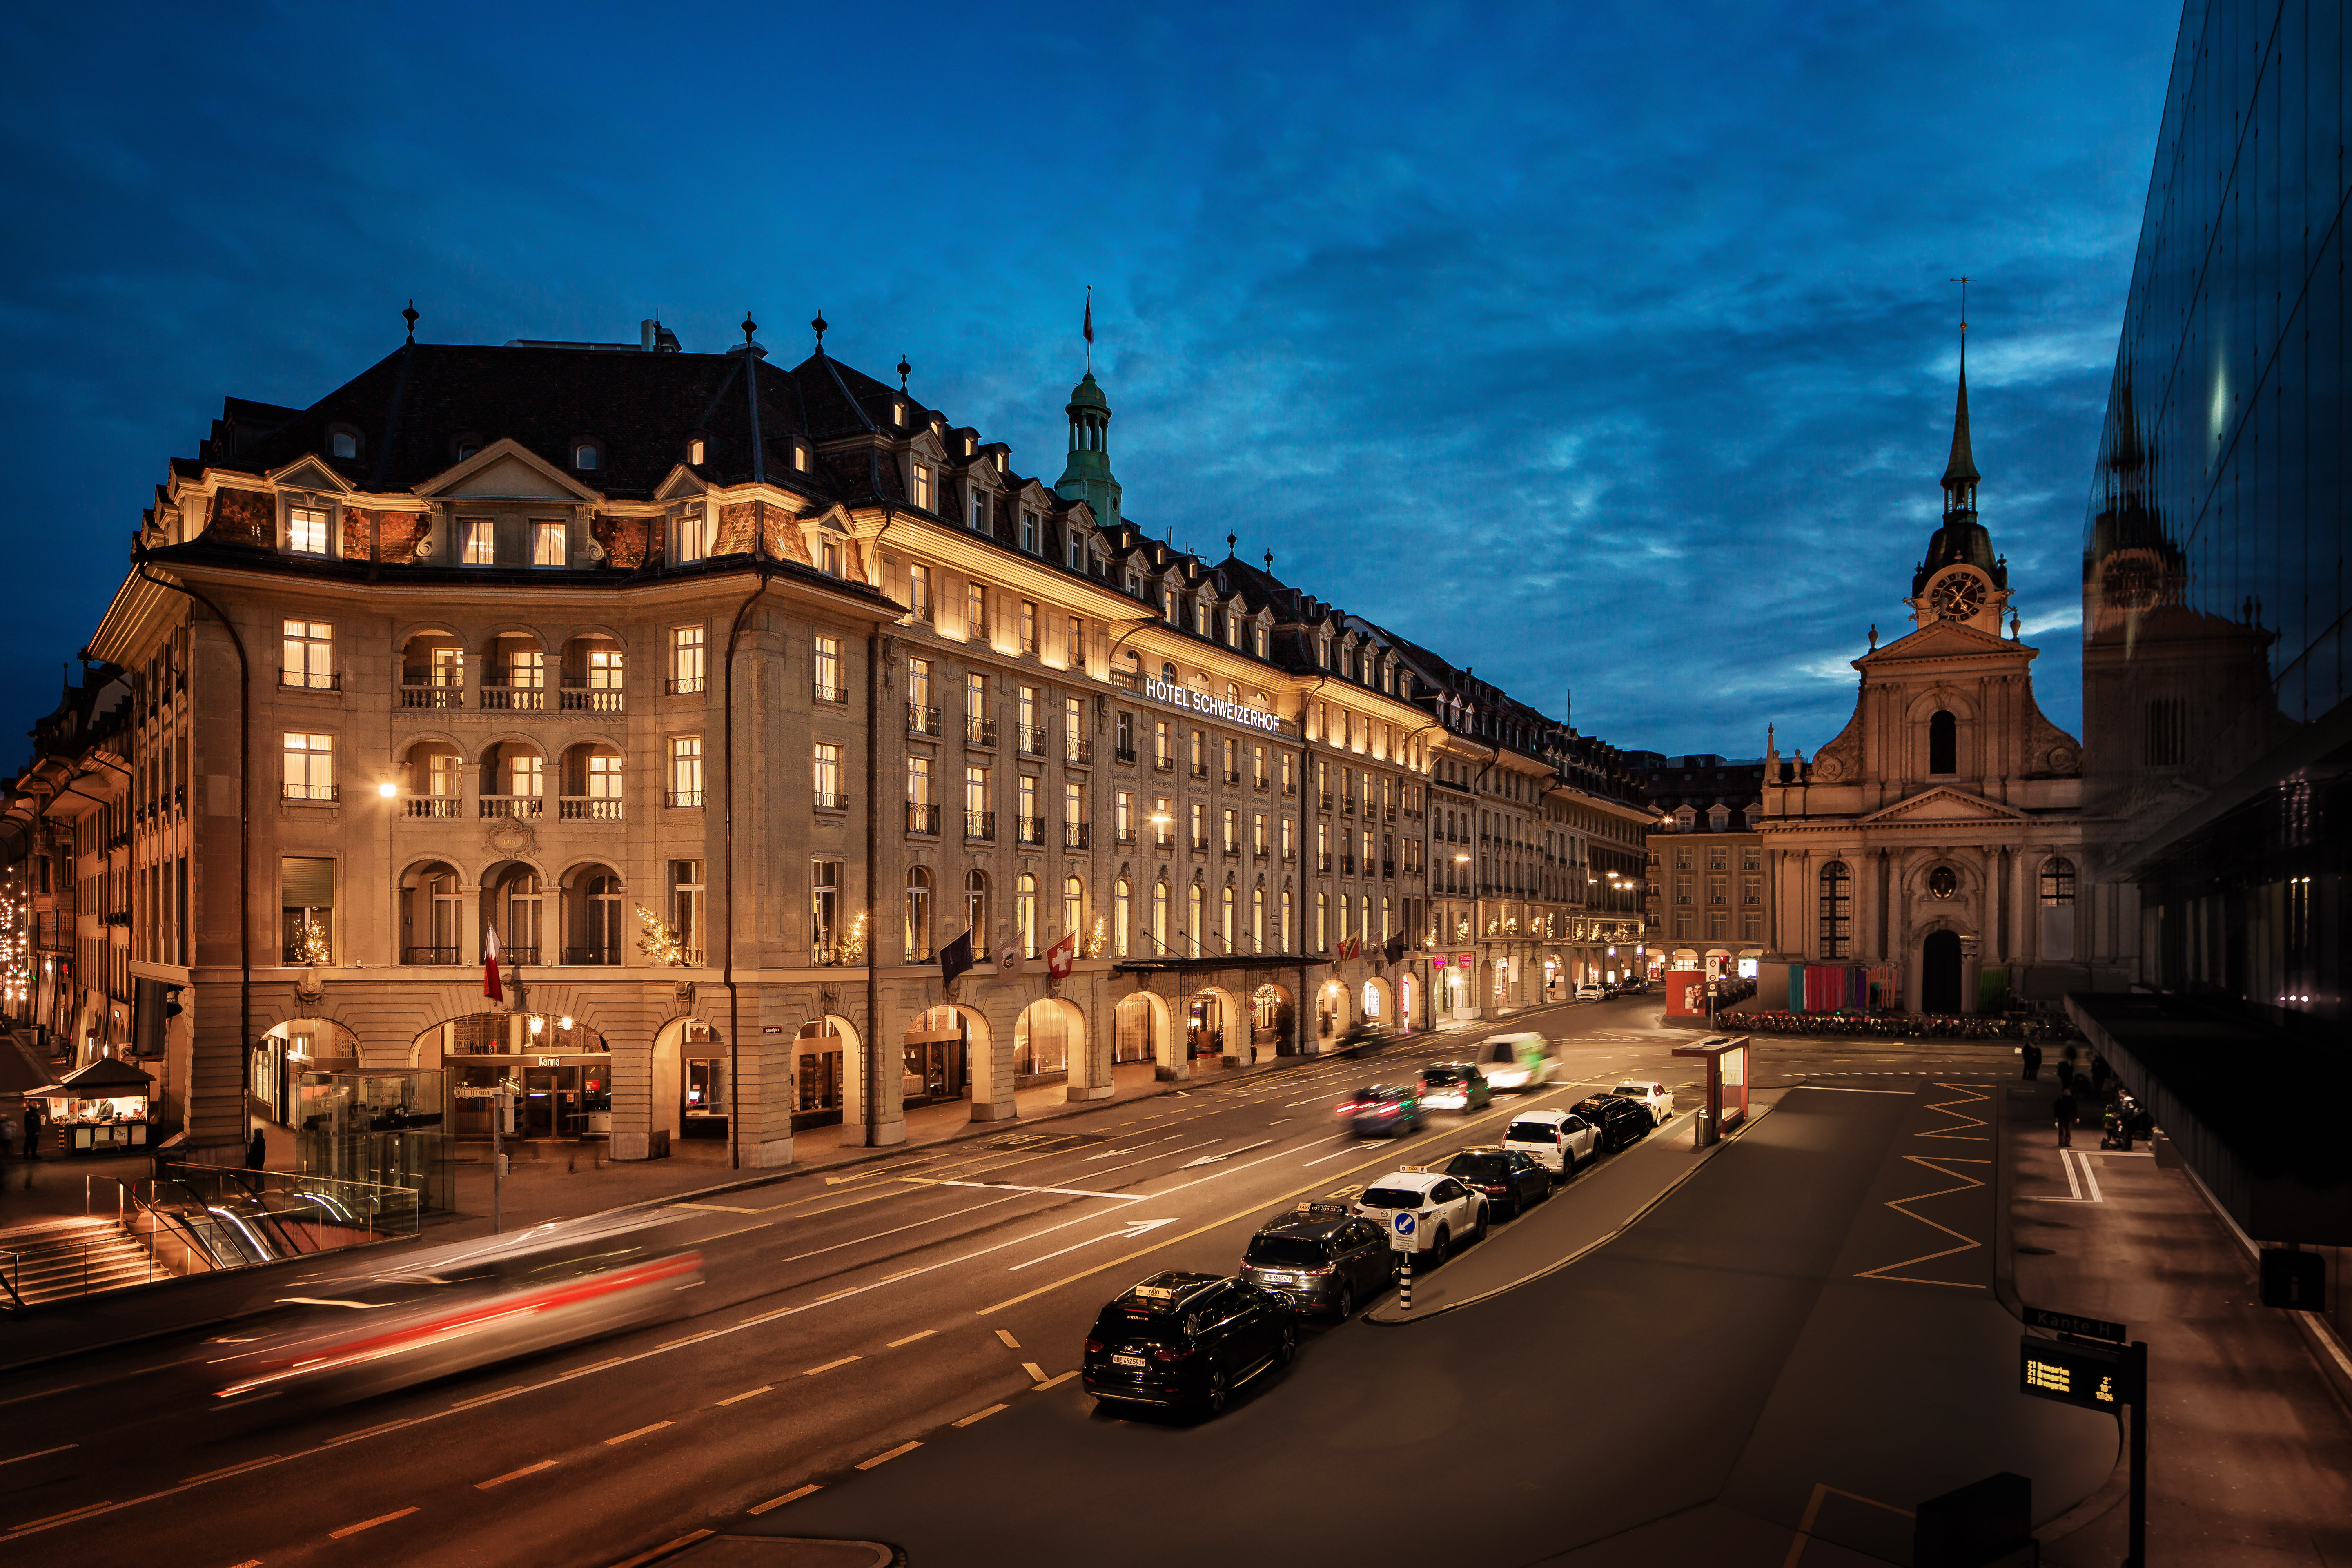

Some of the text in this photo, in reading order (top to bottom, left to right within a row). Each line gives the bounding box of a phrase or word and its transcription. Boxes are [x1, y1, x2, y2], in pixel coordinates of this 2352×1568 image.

[1147, 678, 1280, 732] HOTEL SCHWEIZERHOF
[539, 1056, 560, 1066] Karma
[2038, 1311, 2110, 1336] Kante H
[2027, 1360, 2036, 1368] 21
[2027, 1368, 2036, 1376] 21
[2027, 1376, 2036, 1384] 21
